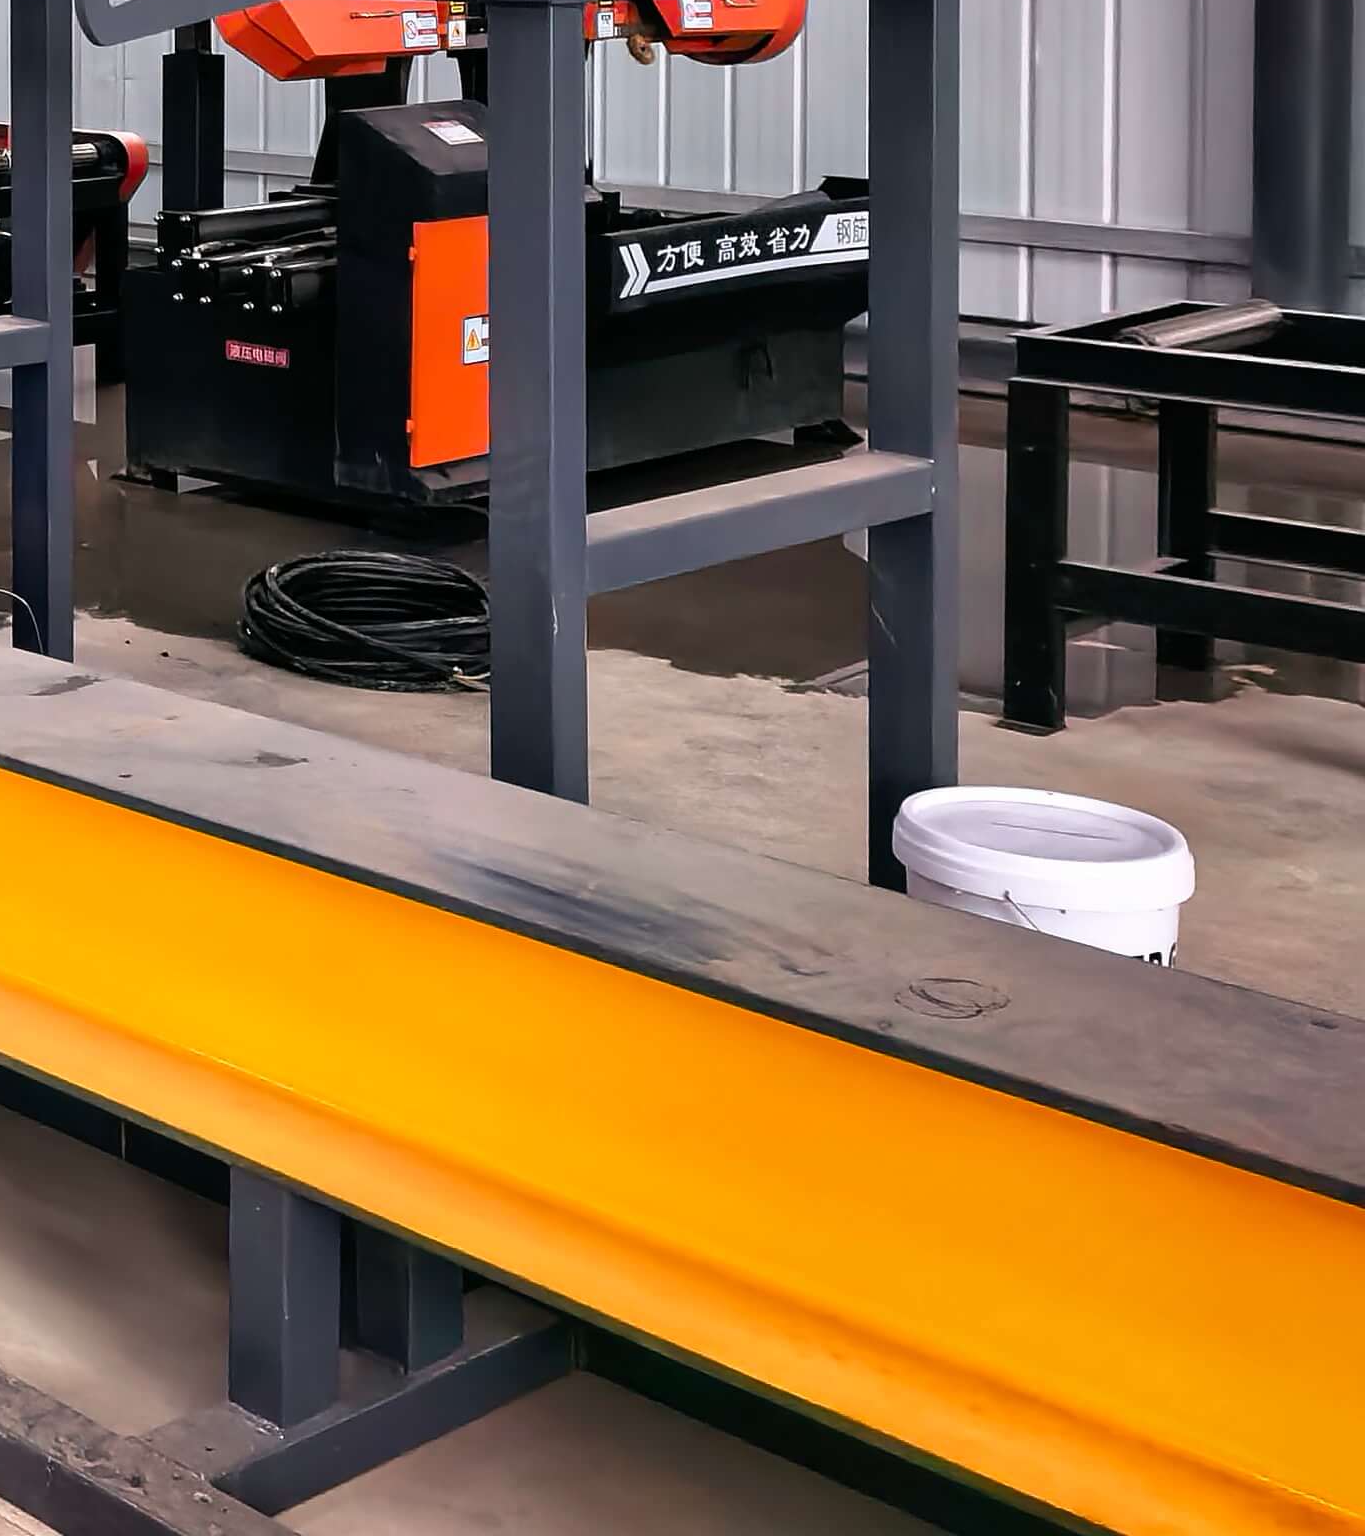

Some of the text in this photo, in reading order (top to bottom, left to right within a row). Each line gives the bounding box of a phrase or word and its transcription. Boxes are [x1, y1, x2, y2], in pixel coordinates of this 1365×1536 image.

[657, 224, 810, 274] 方便 高效 省力
[229, 342, 287, 366] 液压电磁阀
